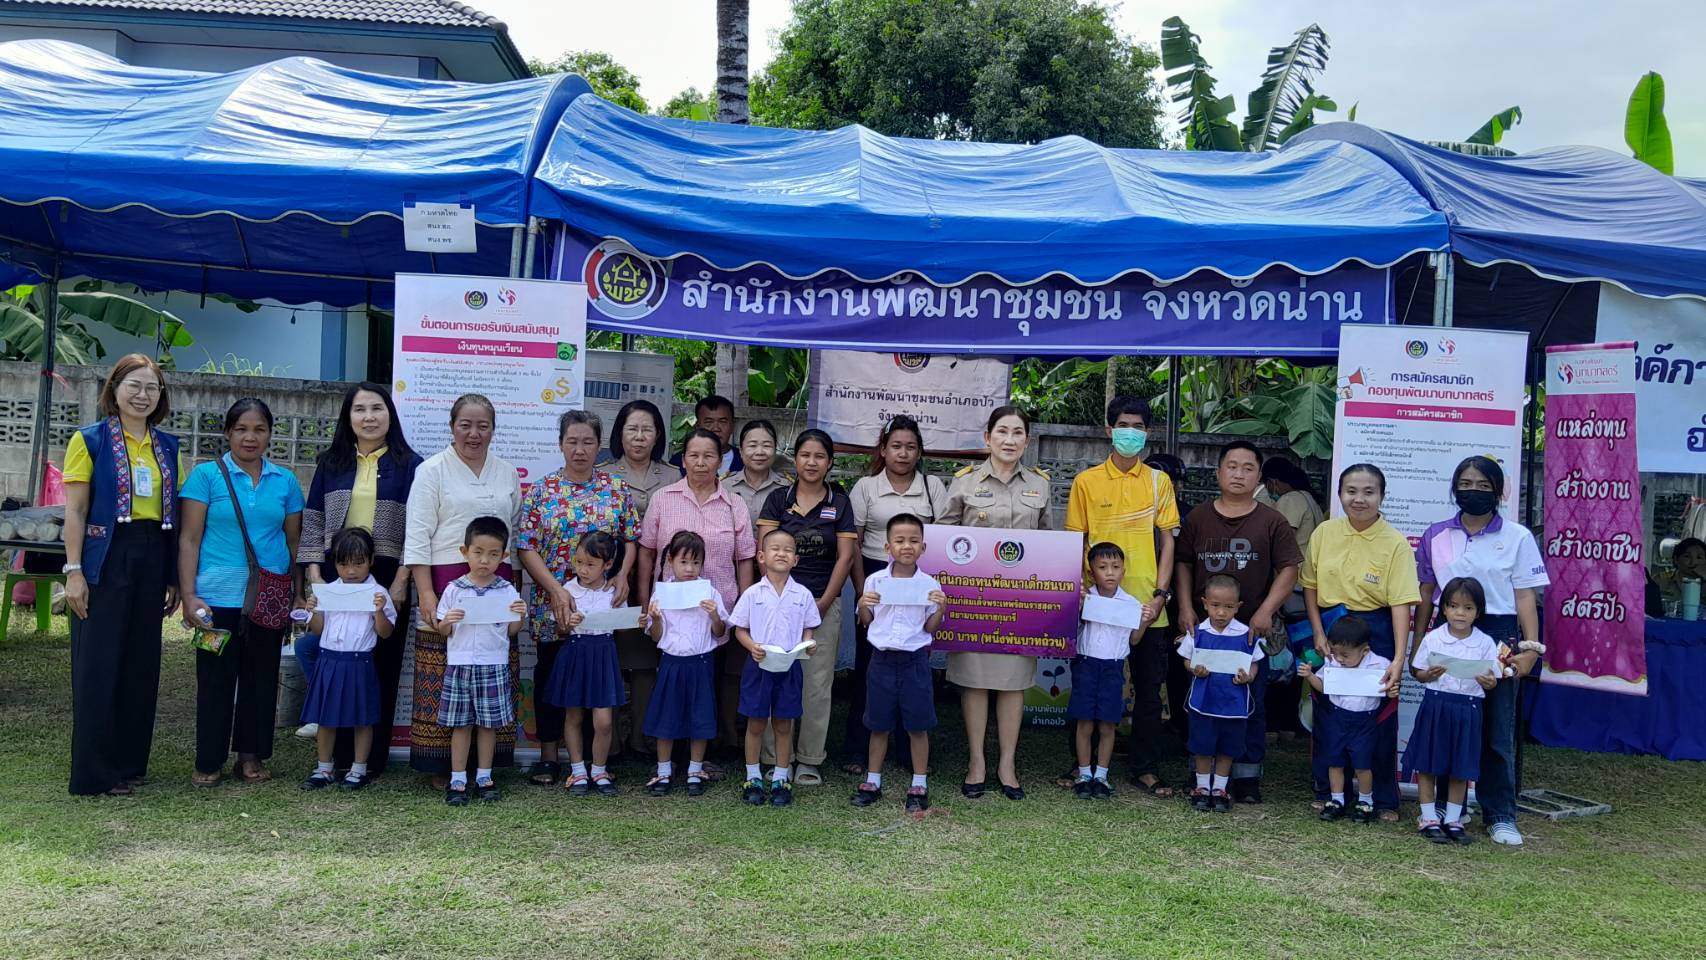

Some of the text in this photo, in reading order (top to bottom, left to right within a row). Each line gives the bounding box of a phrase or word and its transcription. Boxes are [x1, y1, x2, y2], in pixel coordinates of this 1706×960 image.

[682, 270, 1363, 336] สำนักงานพัฒนาชุมชน จังหวัดน่าน
[420, 315, 560, 338] ขั้นตอนการขอรับเงินสนับสนุน
[457, 340, 523, 356] เงินทุนหมุนเวียน
[1391, 371, 1474, 386] การสมัครสมาชิก
[825, 385, 995, 408] สำนักงานพัฒนาชุมชนอำเภอปัว
[1368, 386, 1494, 402] กองทุนพัฒนาบทบาทสตรี
[1396, 408, 1463, 419] การสมัครสมาชิก
[1556, 412, 1627, 448] แหล่งทุน
[1555, 471, 1630, 500] สร้างงาน
[1548, 530, 1640, 562] สร้างอาชีพ
[934, 571, 1074, 592] เงินกองทุนพัฒนาเด็กชนบท
[1561, 593, 1625, 622] สตรีปัว
[933, 628, 1066, 650] ,000 บาท (หนึ่งพันบาทถ้วน)
